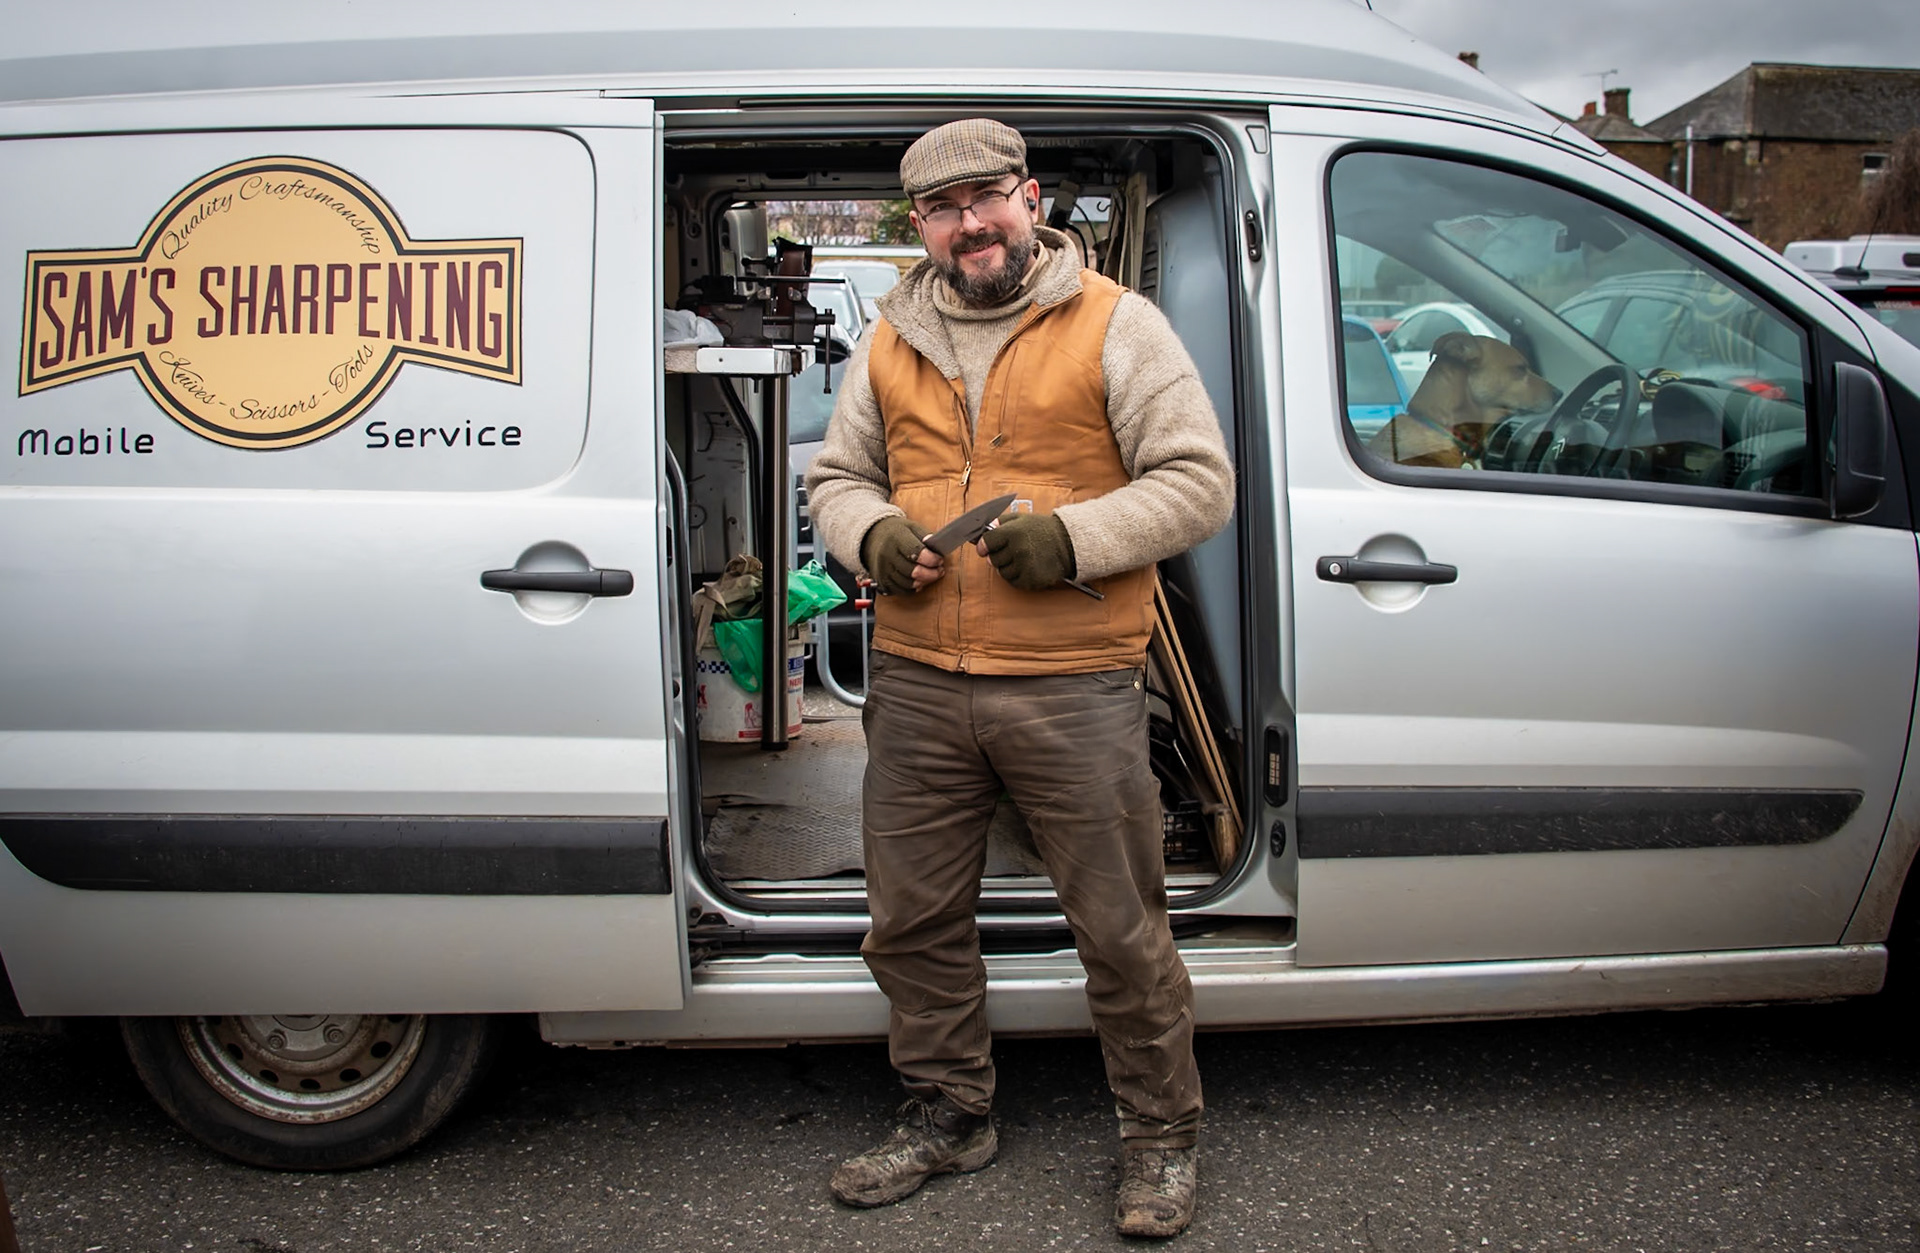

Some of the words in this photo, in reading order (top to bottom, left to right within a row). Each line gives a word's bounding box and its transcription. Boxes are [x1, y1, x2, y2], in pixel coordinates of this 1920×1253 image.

[161, 193, 233, 259] Quality
[239, 175, 381, 255] Craftsmanship
[40, 266, 176, 370] SAM'S
[197, 260, 503, 359] SHARPENING
[159, 350, 215, 405] Knives
[230, 398, 320, 420] Scissors
[328, 344, 374, 395] Tools
[18, 428, 154, 456] Mobile
[366, 419, 522, 448] Service
